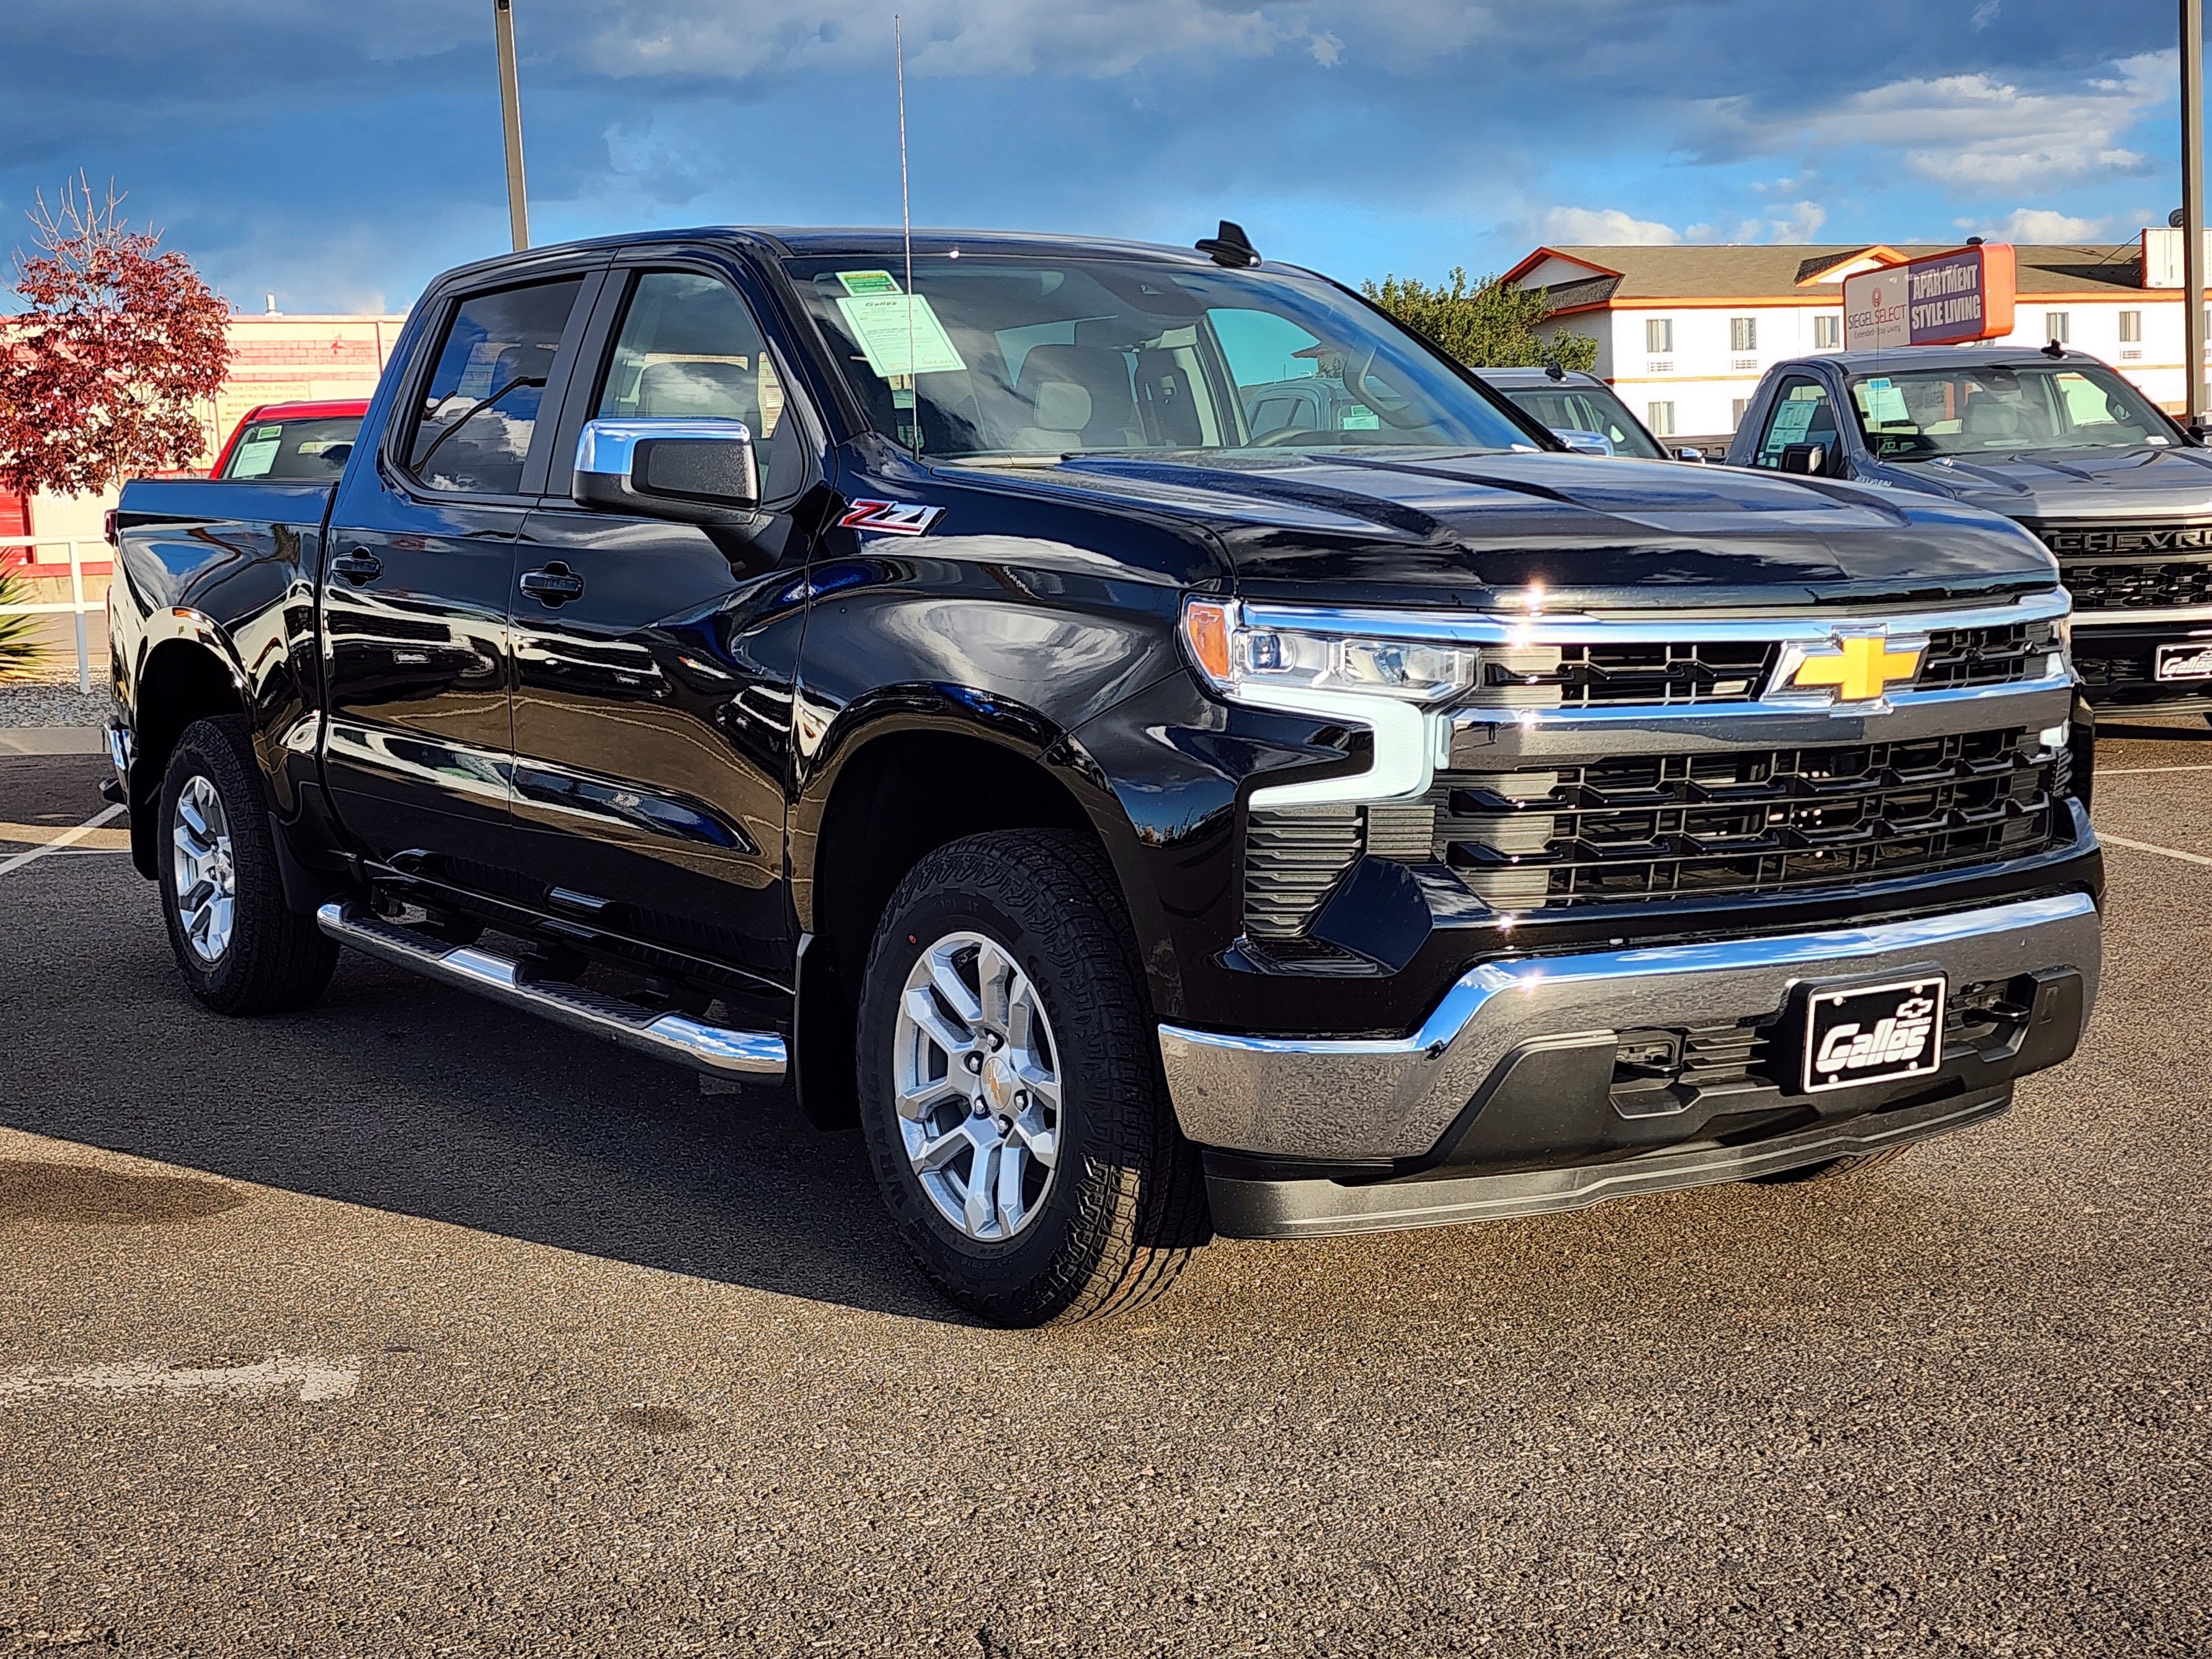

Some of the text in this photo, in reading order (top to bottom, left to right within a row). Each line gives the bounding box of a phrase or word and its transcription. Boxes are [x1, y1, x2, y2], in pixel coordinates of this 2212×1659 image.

[1913, 264, 1978, 300] APARTMENT
[1848, 304, 1907, 330] SIEGEL SELECT
[1912, 294, 1981, 330] STYLE LIVING
[837, 498, 947, 536] Z71
[2053, 529, 2212, 550] CHEVR
[1815, 1018, 1931, 1073] Galles
